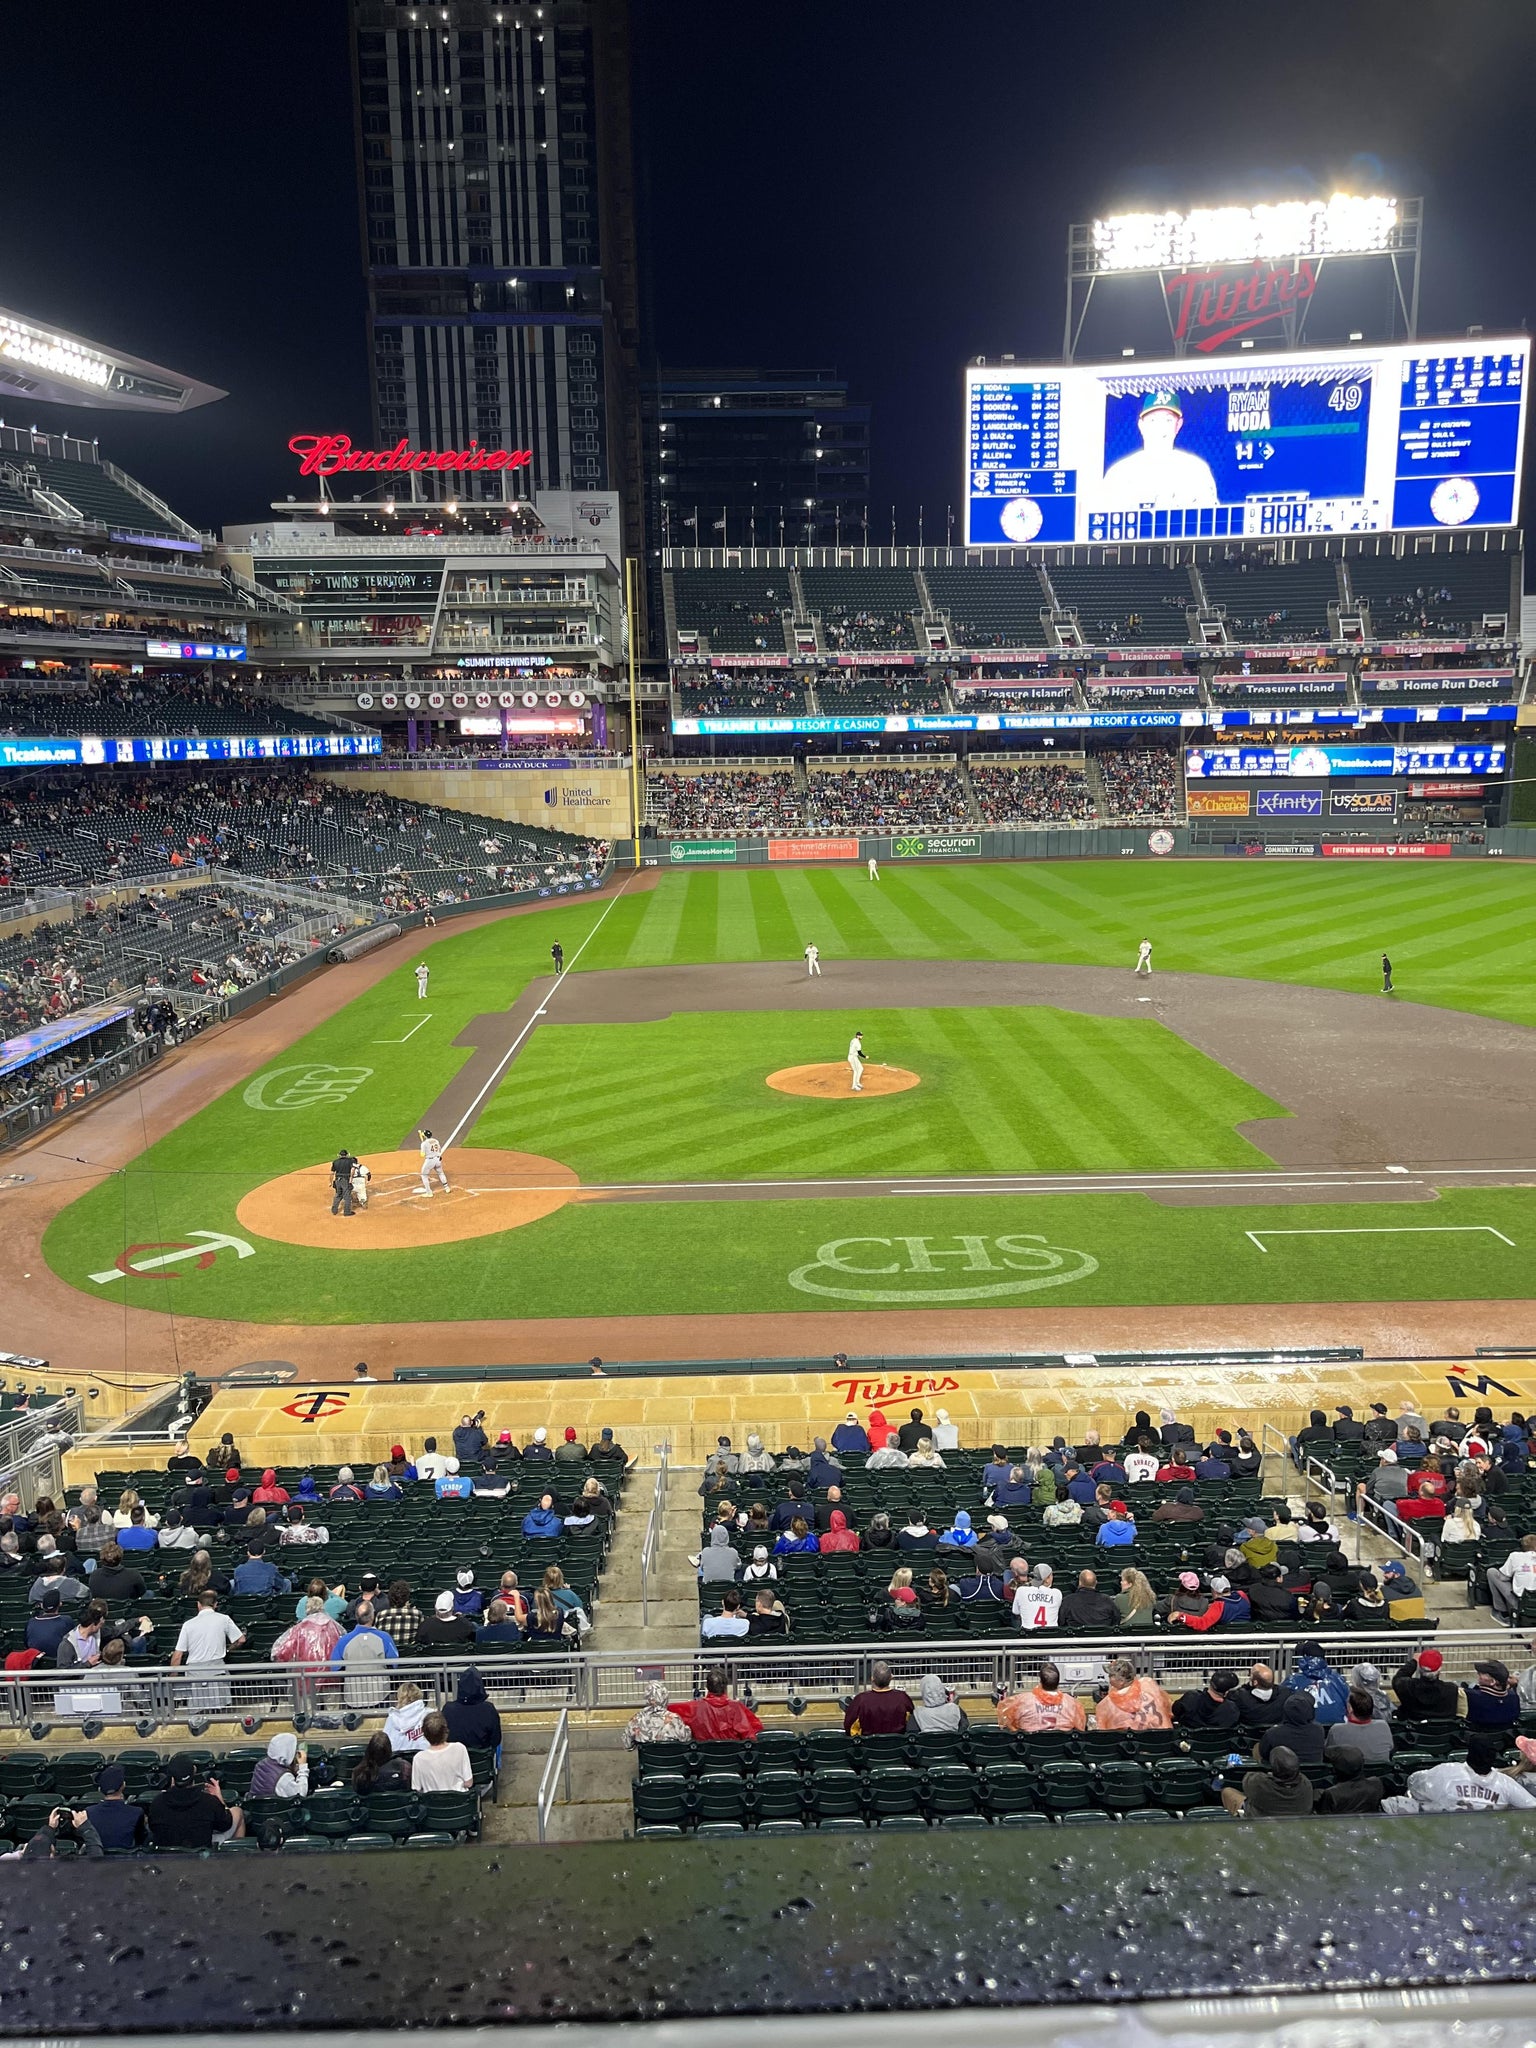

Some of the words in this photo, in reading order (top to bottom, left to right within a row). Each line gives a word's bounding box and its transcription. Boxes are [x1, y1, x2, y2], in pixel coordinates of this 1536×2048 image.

[1166, 258, 1316, 340] Twins
[1228, 390, 1270, 412] RYAN
[1328, 386, 1362, 411] 49
[1228, 411, 1271, 432] NODA
[288, 434, 533, 476] Budweiser
[1250, 508, 1255, 518] 0
[1315, 511, 1322, 522] 2
[1362, 509, 1368, 520] 2
[1249, 524, 1255, 533] 5
[276, 578, 306, 588] WELCOME
[325, 576, 359, 589] TWINS
[364, 575, 417, 587] TERRITORY
[312, 620, 325, 632] WE
[328, 619, 343, 632] ARE
[346, 619, 361, 631] ALL
[465, 657, 494, 668] SUMMIT
[495, 657, 530, 667] BREWING
[530, 657, 546, 667] PUB
[1246, 684, 1296, 693] Treasure
[1300, 683, 1334, 693] Island
[1404, 680, 1438, 690] Home
[1442, 680, 1465, 689] Run
[1469, 678, 1499, 688] Deck
[1032, 689, 1064, 698] Island
[1145, 687, 1166, 695] Run
[1169, 686, 1195, 695] Deck
[361, 697, 370, 705] 42
[385, 696, 395, 705] 36
[410, 696, 416, 705] 7
[432, 696, 440, 704] 10
[478, 695, 489, 704] 34
[502, 695, 511, 703] 14
[527, 695, 533, 703] 6
[551, 695, 561, 703] 29
[574, 694, 580, 703] 3
[704, 721, 756, 732] TREASURE
[757, 721, 794, 731] ISLAND
[796, 720, 831, 730] RESORT
[834, 720, 841, 729] &
[843, 720, 880, 729] CASINO
[1004, 717, 1055, 727] TREASURE
[1056, 717, 1092, 726] ISLAND
[1094, 716, 1129, 726] RESORT
[1130, 716, 1137, 725] &
[1140, 715, 1176, 725] CASINO
[562, 788, 592, 796] United
[563, 797, 611, 806] Healthcare
[1205, 800, 1247, 811] Cheerios
[1261, 793, 1319, 813] xfinity
[928, 838, 975, 848] securian
[832, 1375, 960, 1405] Twins
[1445, 1375, 1522, 1397] M
[1134, 1460, 1155, 1468] ARRAEZ
[425, 1468, 434, 1479] 7
[1140, 1469, 1150, 1481] 2
[1027, 1593, 1054, 1604] CORREA
[1034, 1606, 1047, 1627] 4
[1455, 1785, 1500, 1803] BERGUM
